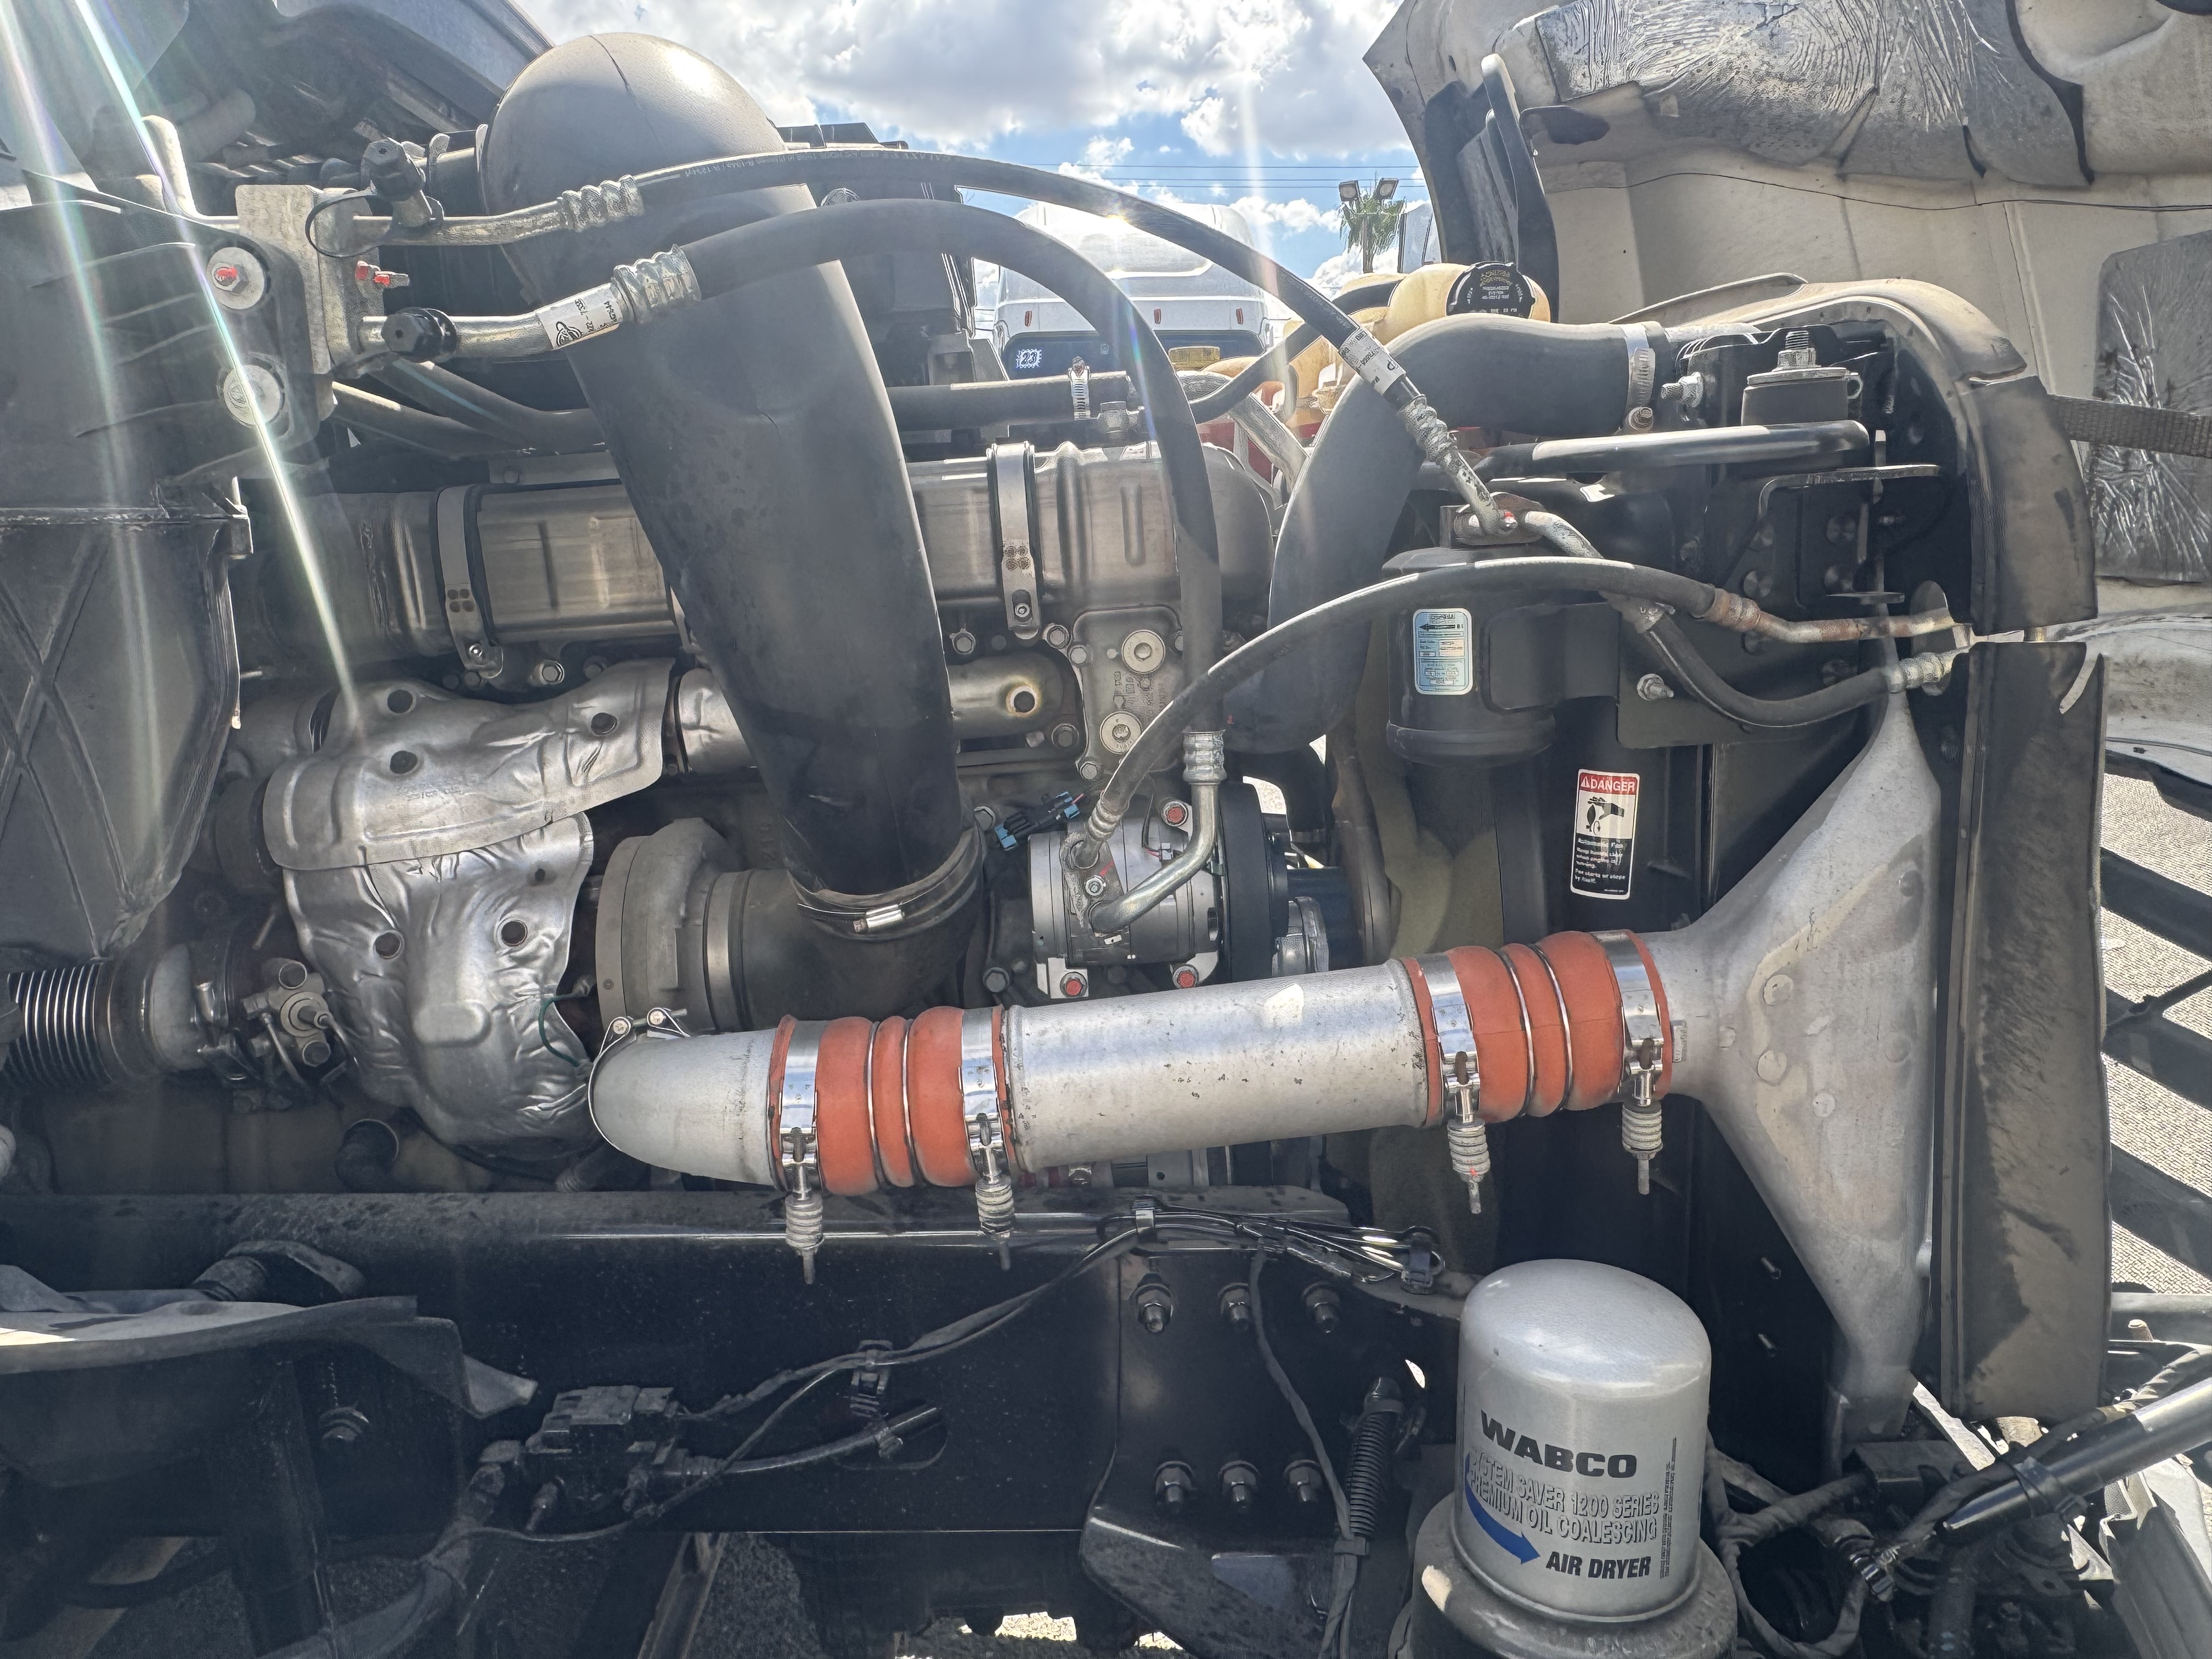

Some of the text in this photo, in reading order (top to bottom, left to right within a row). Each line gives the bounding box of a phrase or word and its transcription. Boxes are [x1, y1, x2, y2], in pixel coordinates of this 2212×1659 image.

[1591, 778, 1635, 792] DANGER
[1481, 1409, 1637, 1478] WABCO
[1516, 1475, 1565, 1513] SAVER
[1571, 1492, 1609, 1518] 1200
[1612, 1491, 1660, 1519] SERIES
[1527, 1505, 1553, 1534] OIL
[1557, 1514, 1657, 1544] COALESCING
[1546, 1551, 1651, 1579] AIR DRYER
